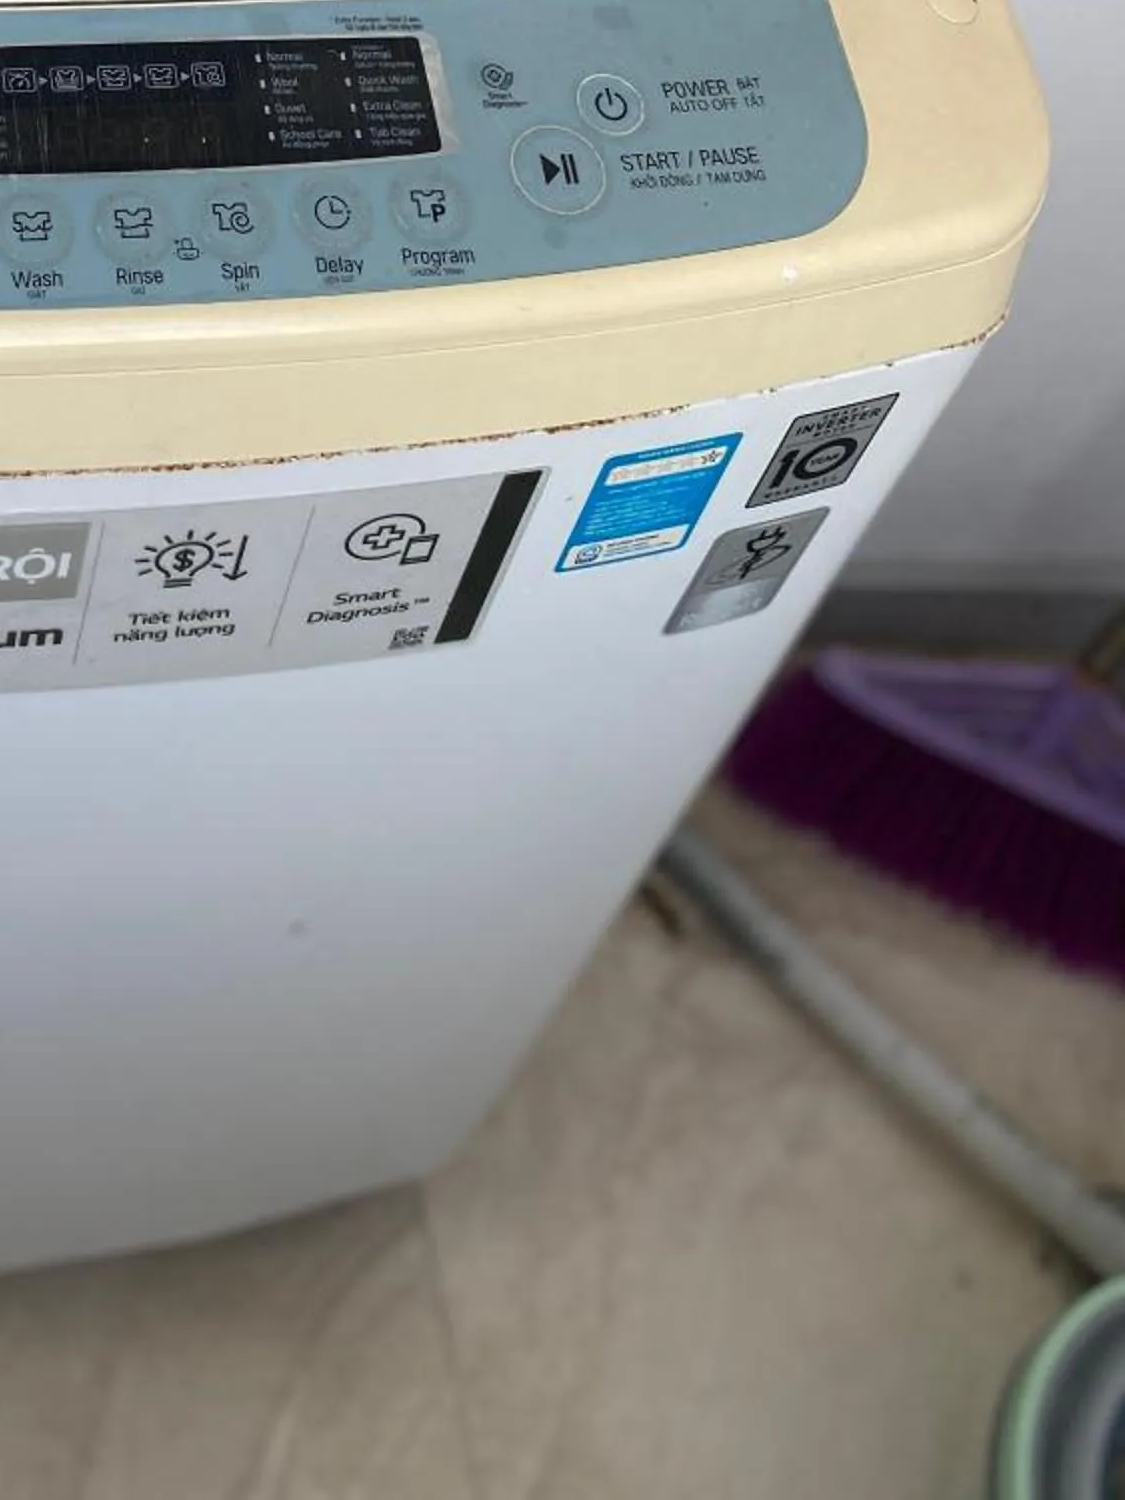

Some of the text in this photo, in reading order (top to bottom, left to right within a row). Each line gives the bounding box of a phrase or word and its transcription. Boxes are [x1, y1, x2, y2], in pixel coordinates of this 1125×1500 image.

[661, 79, 730, 99] POWER
[670, 100, 709, 114] AUTO
[712, 98, 737, 111] OFF
[620, 151, 680, 172] START
[699, 146, 761, 167] PAUSE
[315, 255, 364, 275] Delay
[402, 248, 475, 268] Program
[11, 270, 64, 289] Wash
[116, 267, 164, 285] Rinse
[220, 261, 260, 282] Spin
[794, 407, 883, 437] INVERTER
[769, 437, 858, 489] 10
[331, 586, 403, 607] Smart
[126, 610, 172, 627] Tiết
[112, 626, 169, 644] năng
